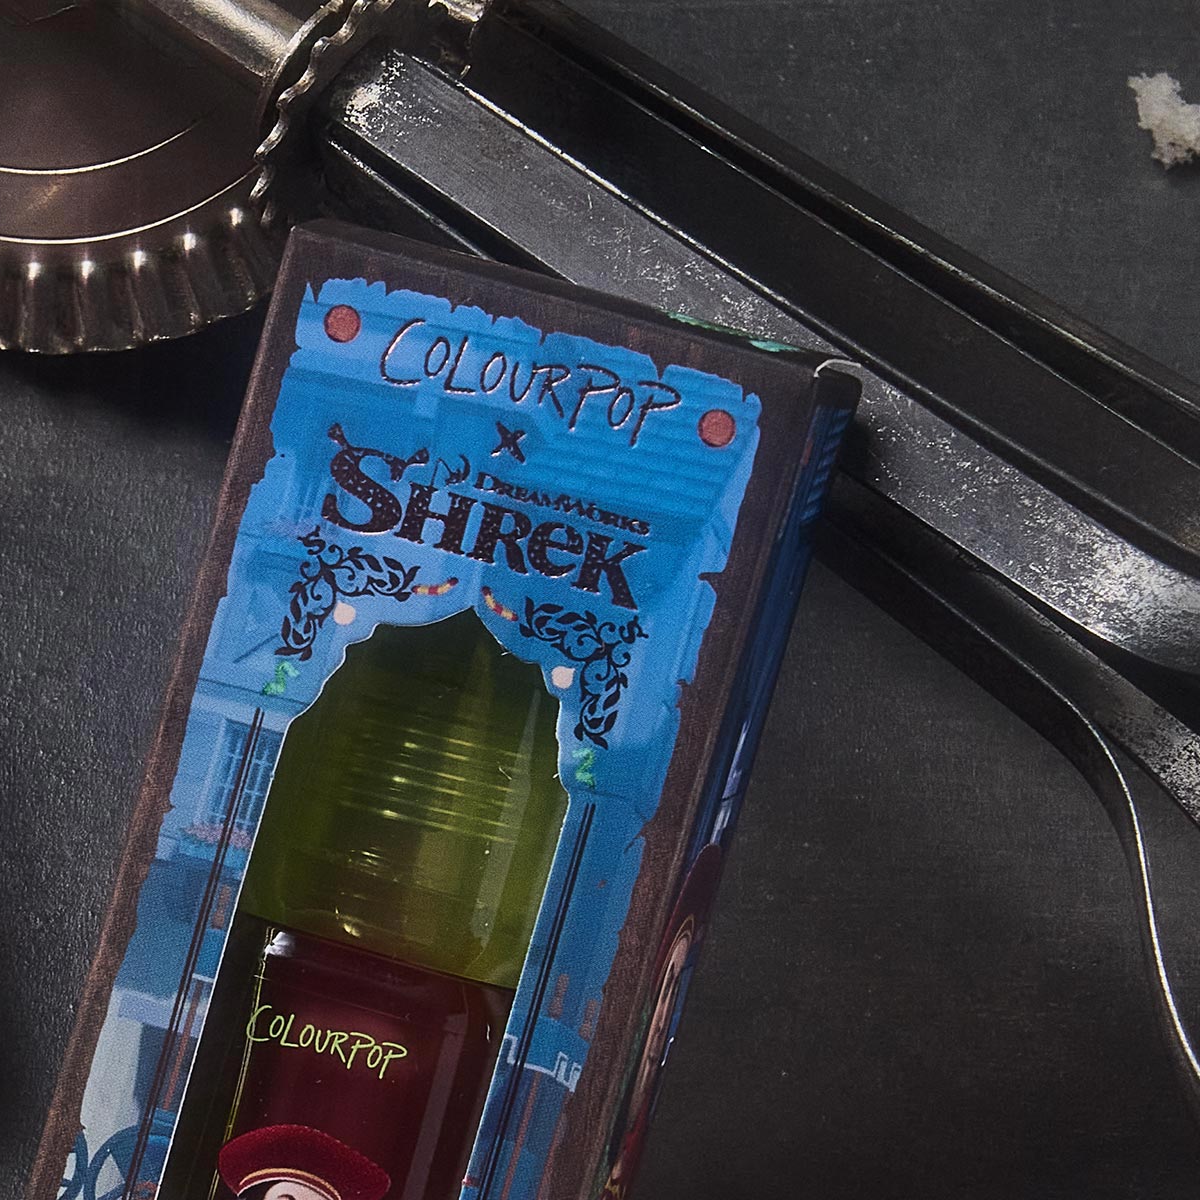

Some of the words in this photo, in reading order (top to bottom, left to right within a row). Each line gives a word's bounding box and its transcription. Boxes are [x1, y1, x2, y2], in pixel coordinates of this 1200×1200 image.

[380, 318, 682, 446] COLOURPOP
[472, 471, 651, 536] DREAMWORKS
[246, 1005, 408, 1079] COLOURPOP
